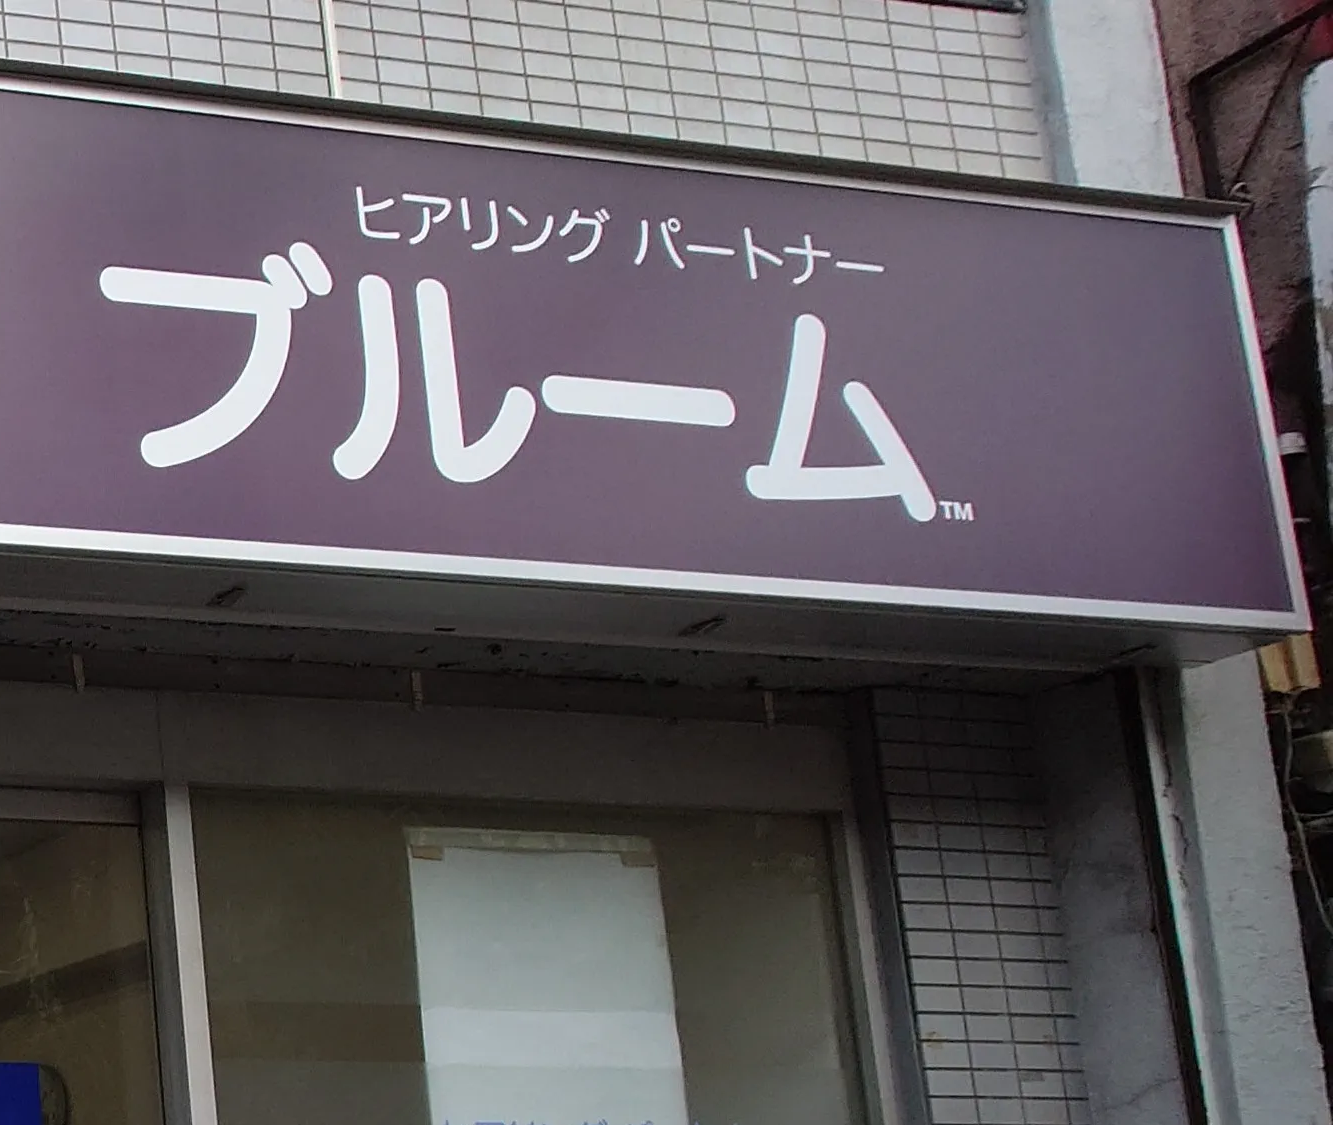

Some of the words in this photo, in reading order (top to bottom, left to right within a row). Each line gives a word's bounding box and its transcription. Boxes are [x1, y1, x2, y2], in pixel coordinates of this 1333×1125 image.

[356, 185, 611, 262] ヒアリング
[635, 218, 884, 284] パートナー
[99, 242, 936, 522] ブルーム
[939, 501, 973, 522] TM
